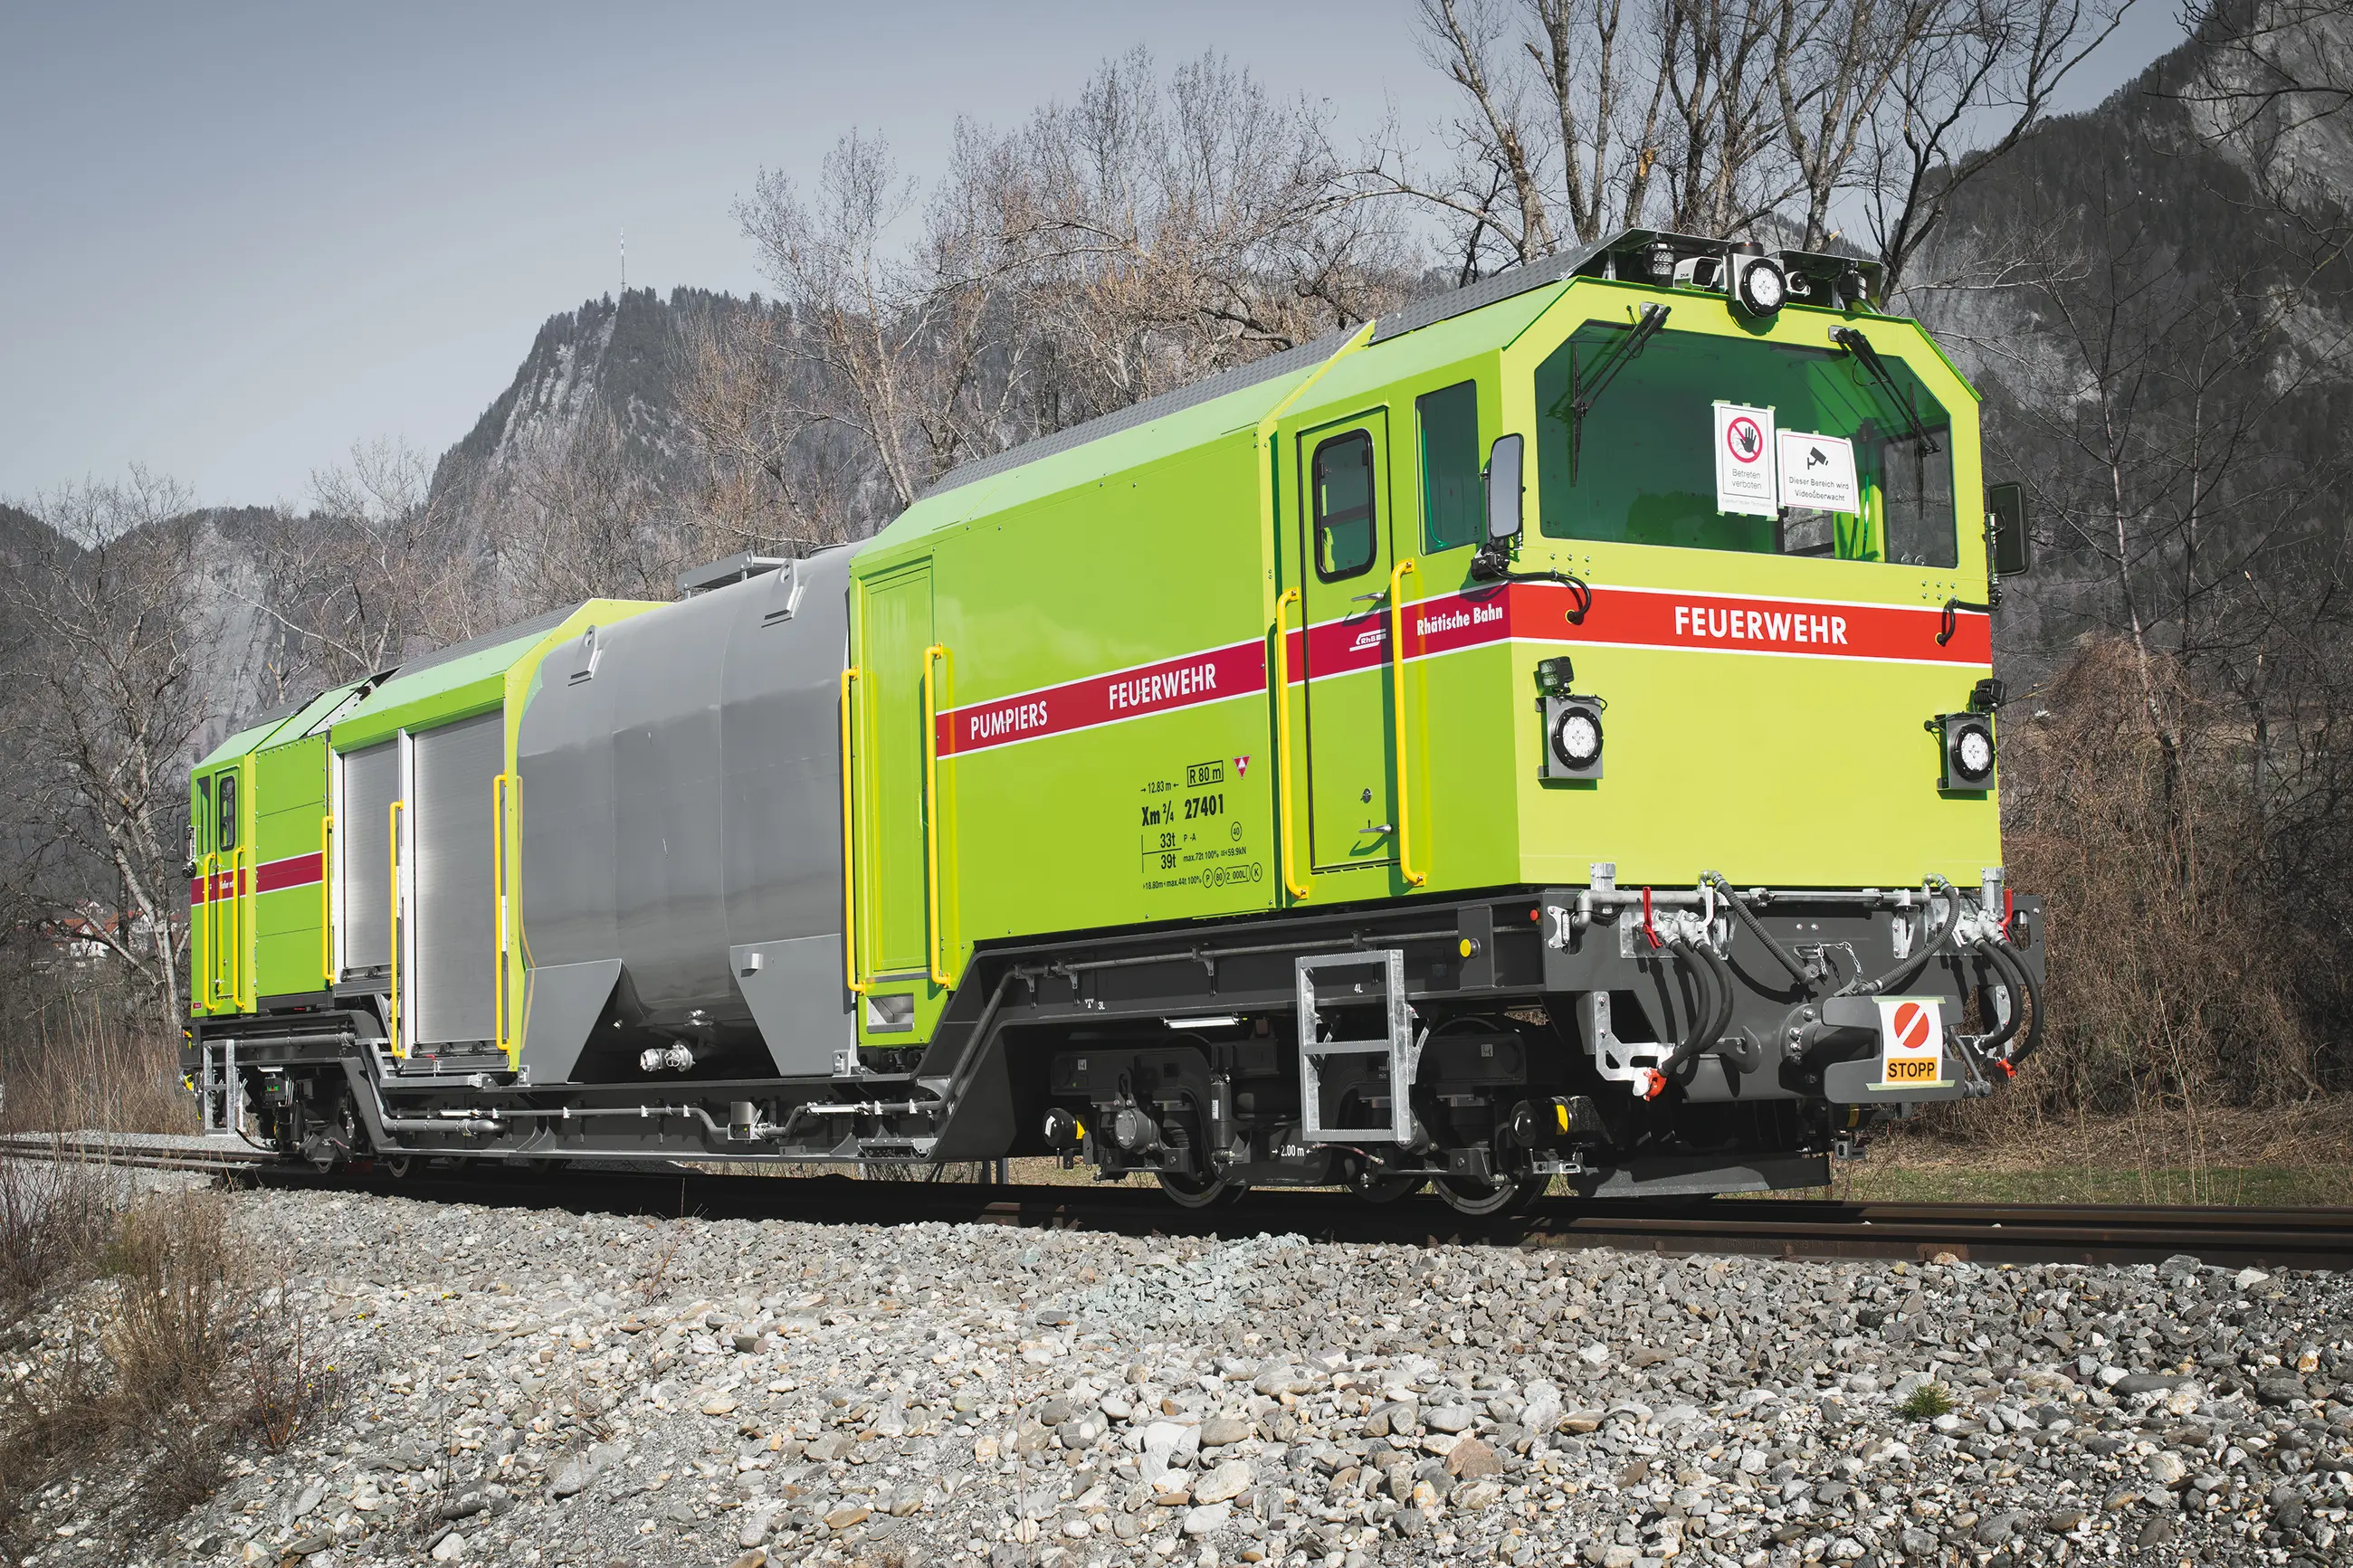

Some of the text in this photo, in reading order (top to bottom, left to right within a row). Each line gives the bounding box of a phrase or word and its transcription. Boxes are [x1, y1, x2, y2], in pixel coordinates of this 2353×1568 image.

[1732, 469, 1760, 479] Betreten
[1732, 480, 1762, 489] verboten
[1789, 476, 1849, 490] Dieser Bereich wird
[1795, 489, 1845, 501] Videoüberwacht
[1417, 603, 1503, 636] Rhätische Bahn
[1674, 606, 1848, 645] FEUERWEHR
[970, 663, 1217, 740] PUMPIERS FEUERWEHR
[1189, 766, 1221, 784] R 80 m
[1148, 781, 1171, 794] 12.83 m
[1141, 806, 1160, 826] Xm
[1184, 794, 1224, 820] 27401
[1233, 827, 1240, 836] 40
[1160, 832, 1176, 848] 33t
[1161, 853, 1176, 870] 39t
[1354, 983, 1363, 993] 4L
[1888, 1062, 1935, 1078] STOPP
[1281, 1144, 1305, 1157] 2.00 m
